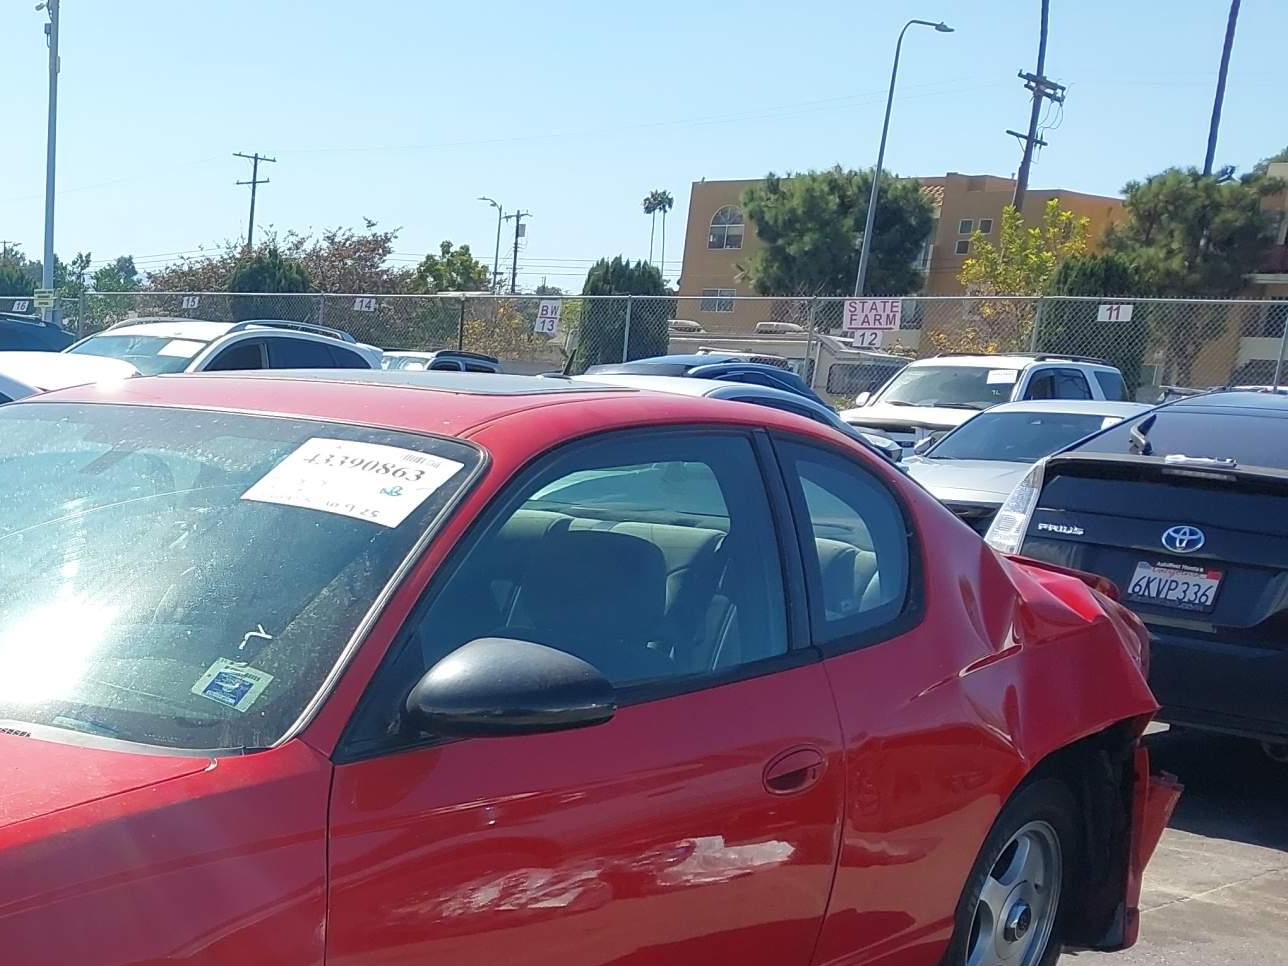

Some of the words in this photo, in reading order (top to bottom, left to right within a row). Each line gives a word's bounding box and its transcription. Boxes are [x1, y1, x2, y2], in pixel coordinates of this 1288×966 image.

[359, 299, 372, 310] 14
[541, 304, 559, 316] BW
[848, 300, 900, 313] STATE
[1106, 305, 1121, 320] 11
[540, 319, 555, 331] 13
[849, 313, 897, 326] FARM
[859, 332, 878, 346] 12
[1037, 523, 1084, 535] PRIUS
[1132, 575, 1214, 605] 6KVP336
